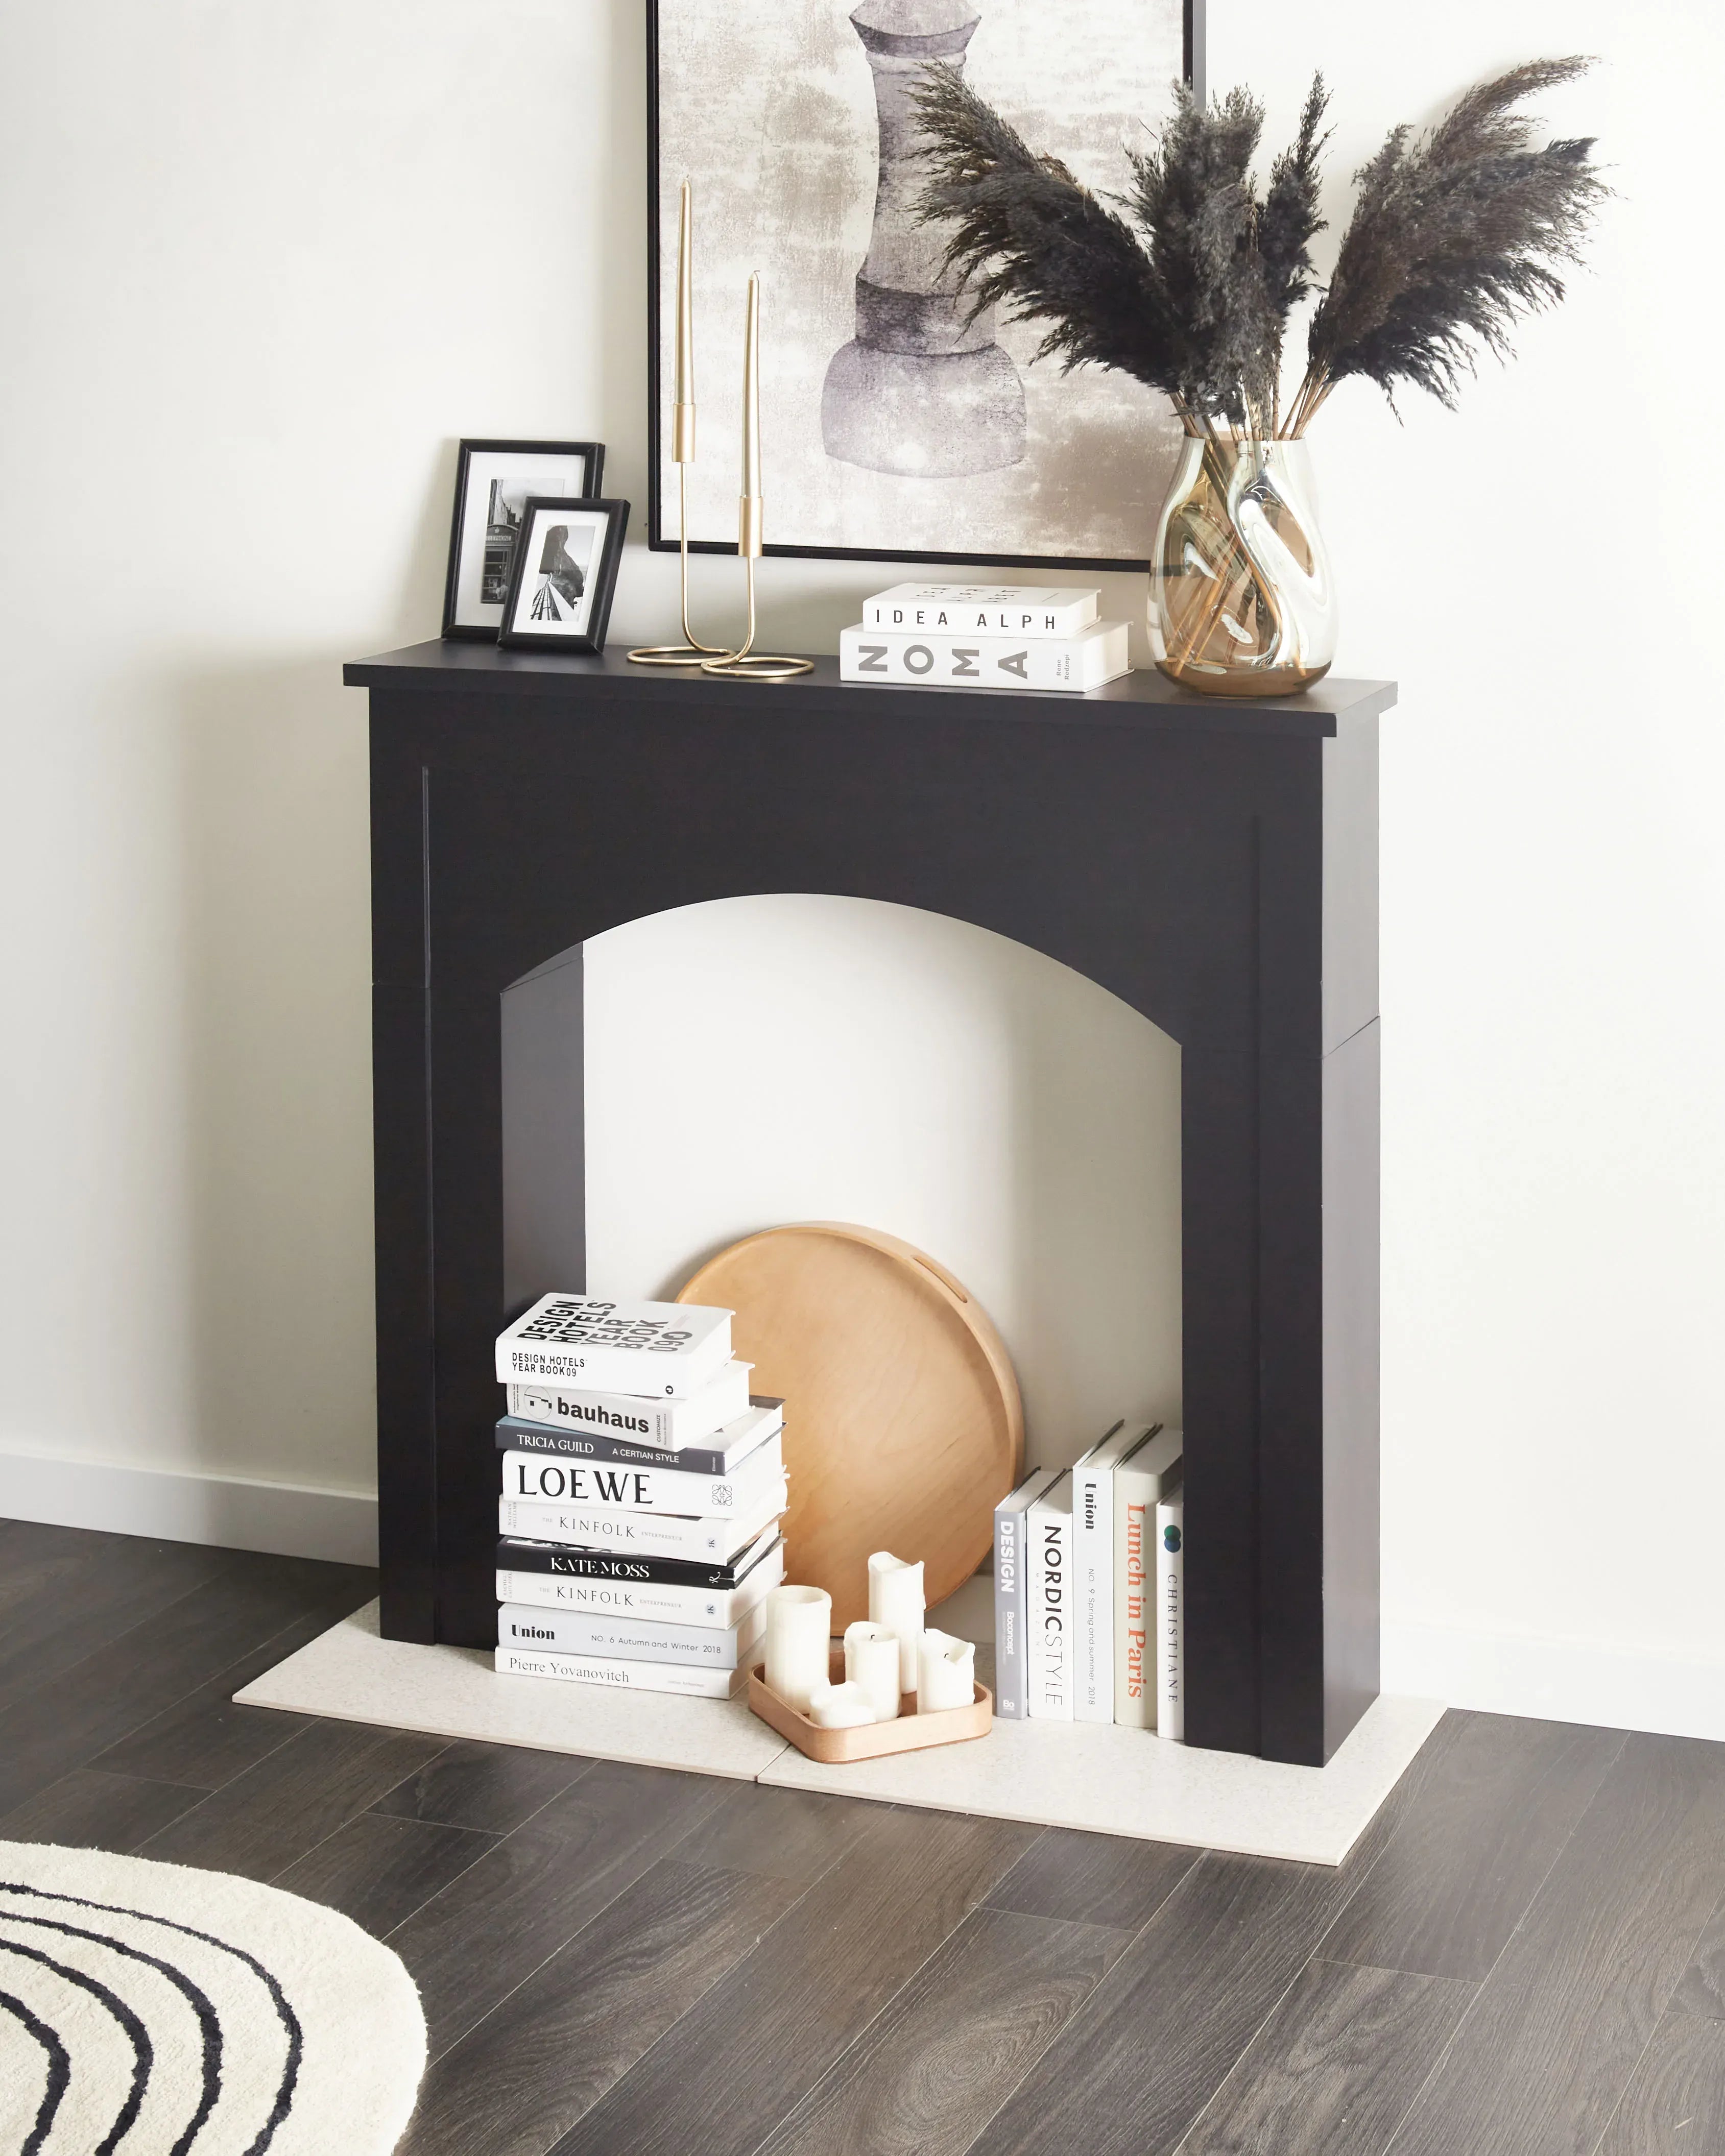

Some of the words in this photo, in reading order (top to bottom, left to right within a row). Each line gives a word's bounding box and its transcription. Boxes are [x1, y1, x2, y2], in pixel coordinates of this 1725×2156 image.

[876, 609, 948, 625] IDEA
[976, 613, 1055, 629] ALPH
[858, 644, 1028, 680] NOMA
[517, 1300, 584, 1340] DESIGN
[549, 1301, 617, 1344] HOTELS
[581, 1319, 637, 1347] YEAR
[613, 1319, 669, 1349] BOOK
[512, 1352, 546, 1364] DESIGN
[549, 1356, 585, 1367] HOTELS
[512, 1362, 536, 1373] YEAR
[558, 1397, 650, 1433] bauhaus
[516, 1434, 556, 1449] TRICIA
[558, 1440, 594, 1454] GUILD
[619, 1448, 654, 1460] CERTIAN
[655, 1451, 680, 1463] STYLE
[518, 1465, 653, 1504] LOEWE
[1085, 1483, 1097, 1530] Union
[560, 1516, 635, 1538] KINFOLK
[1000, 1521, 1015, 1593] DESIGN
[1128, 1503, 1146, 1586] Lunch
[551, 1557, 597, 1573] KATE
[600, 1561, 650, 1578] MOSS
[557, 1586, 634, 1606] KINFOLK
[1128, 1595, 1147, 1619] in
[1087, 1597, 1095, 1626] Spring
[511, 1624, 555, 1640] Union
[618, 1637, 650, 1646] Autumn
[670, 1642, 699, 1651] Winter
[703, 1645, 721, 1654] 2018
[1167, 1574, 1178, 1702] CHRISTIANE
[510, 1657, 545, 1673] Pierre
[550, 1662, 630, 1683] Yovanovitch
[1128, 1630, 1147, 1698] Paris
